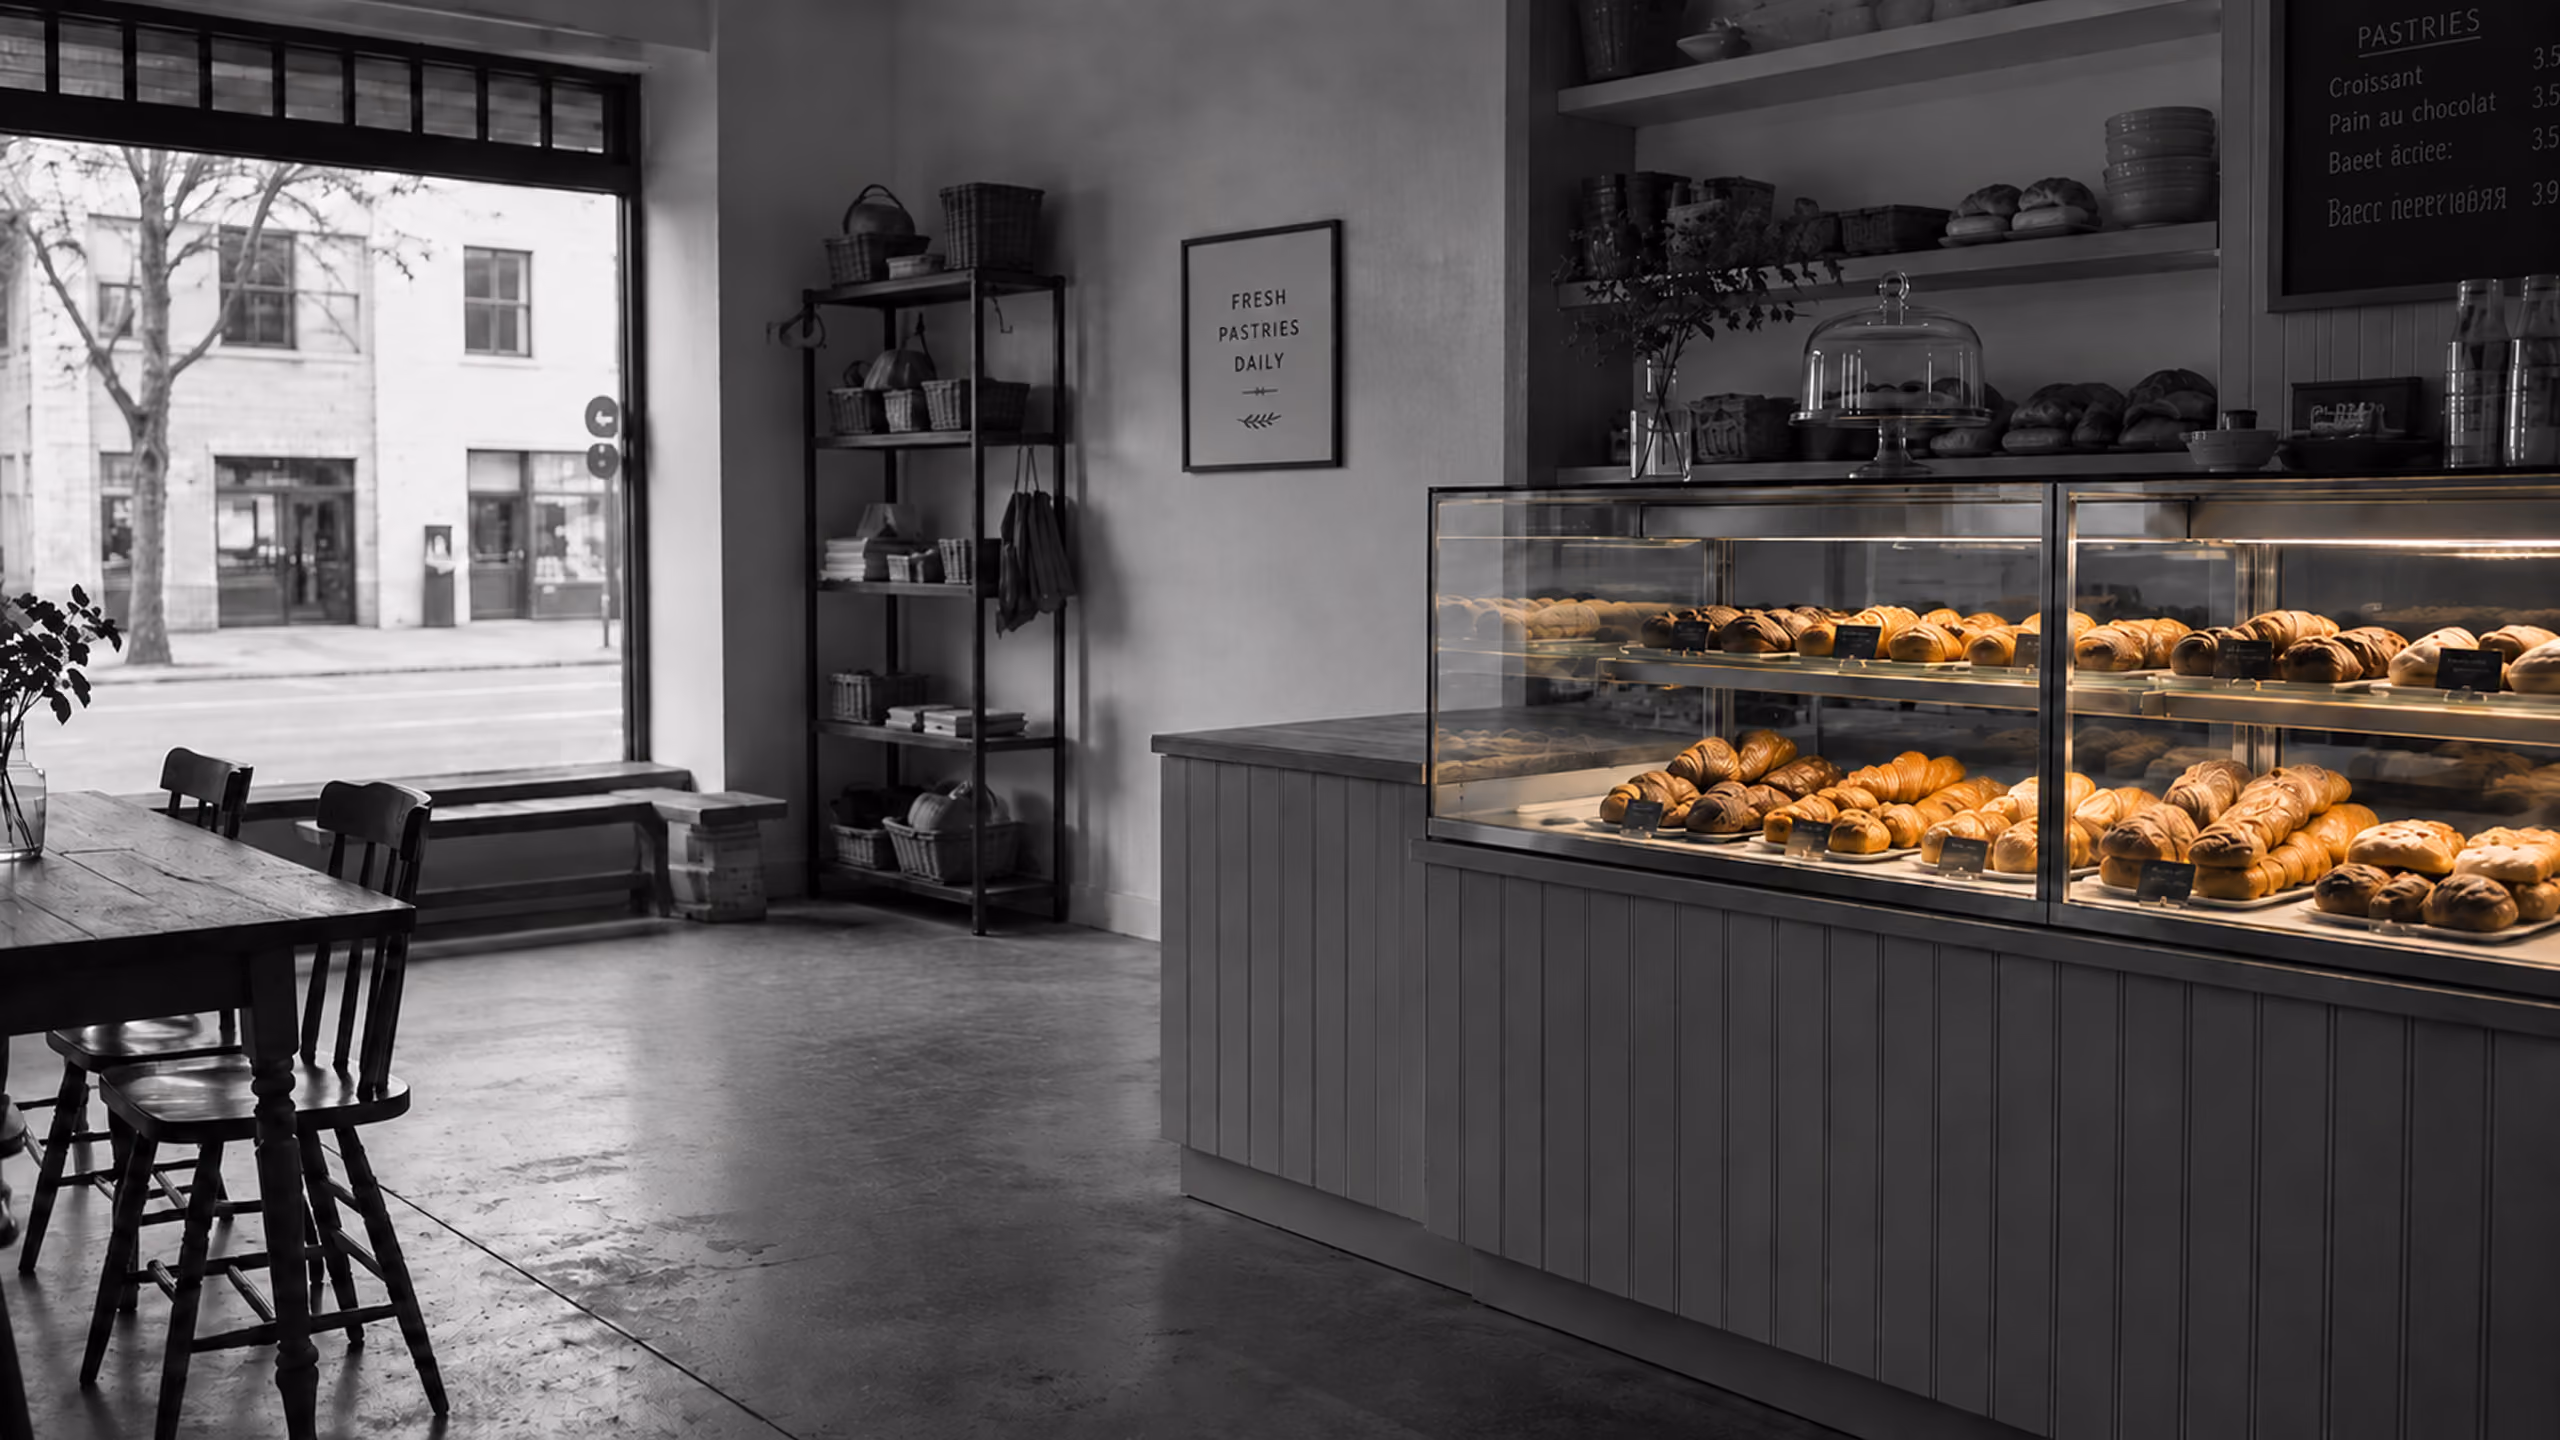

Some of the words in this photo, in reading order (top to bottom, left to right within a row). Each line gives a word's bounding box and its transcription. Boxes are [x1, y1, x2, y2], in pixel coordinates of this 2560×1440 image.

[2358, 8, 2480, 48] PASTRIES
[2329, 65, 2423, 98] Croissant
[2329, 111, 2370, 135] Pain
[2379, 110, 2403, 127] au
[2412, 92, 2497, 123] chocolat
[1231, 289, 1286, 310] FRESH
[1219, 319, 1299, 342] PASTRIES
[1234, 352, 1284, 373] DAILY
